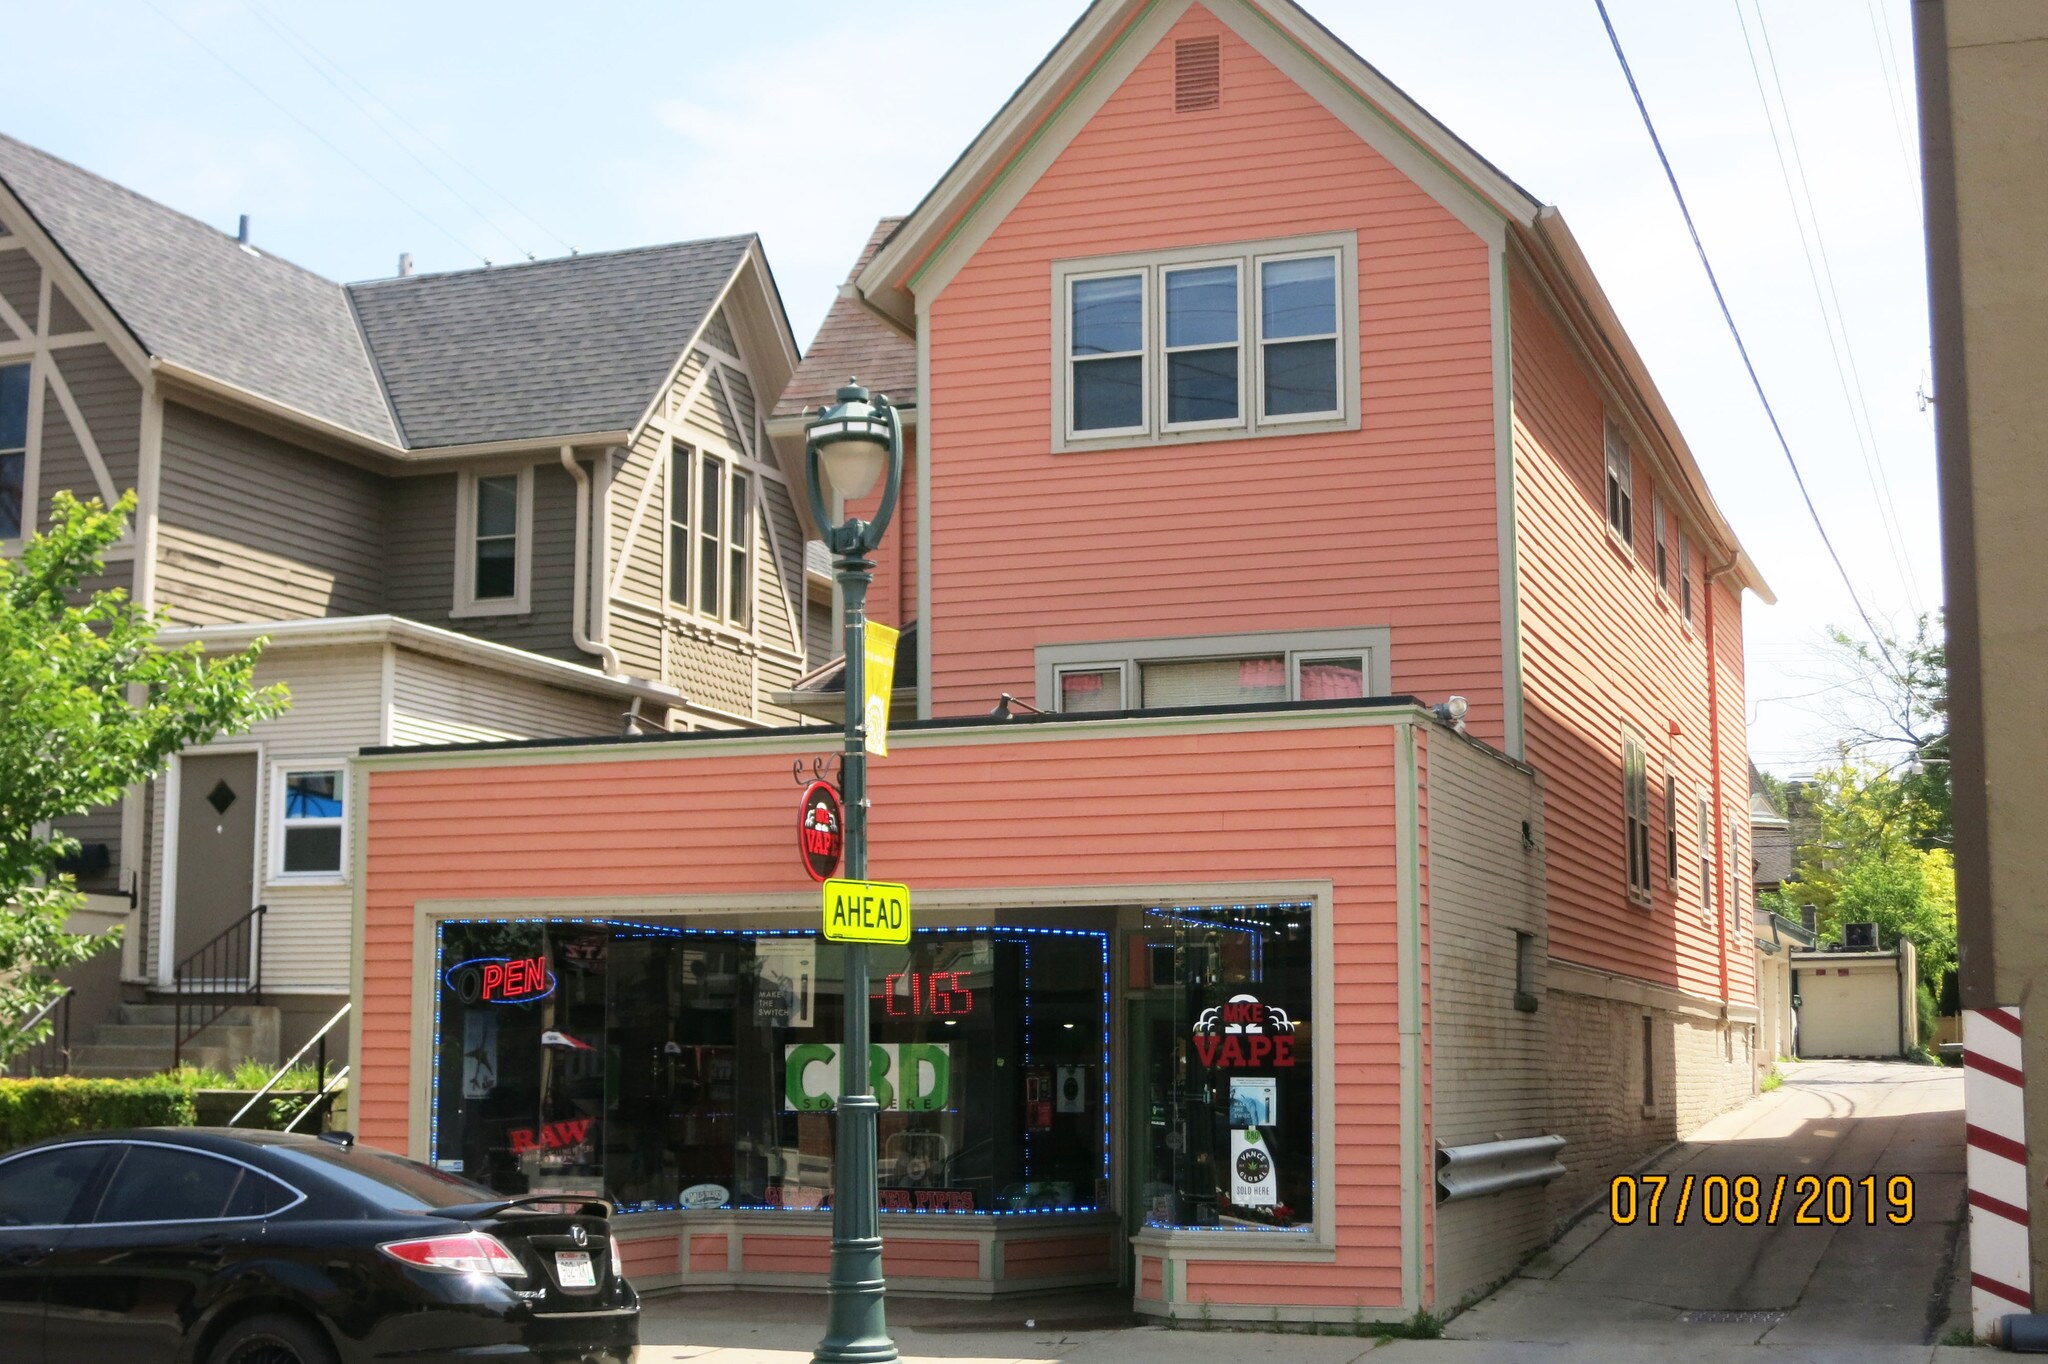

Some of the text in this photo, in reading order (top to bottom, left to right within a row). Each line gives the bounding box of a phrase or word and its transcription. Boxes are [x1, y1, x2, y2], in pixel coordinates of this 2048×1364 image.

[805, 829, 838, 857] VAPE
[833, 895, 903, 930] AHEAD
[458, 956, 546, 1004] OPEN
[758, 1008, 789, 1016] SWITCH
[1222, 1003, 1264, 1022] MKE
[1192, 1035, 1295, 1067] VAPE
[785, 1044, 949, 1111] CBD
[510, 1118, 590, 1154] RAW
[1246, 1131, 1259, 1140] CBD
[1240, 1151, 1266, 1162] VANCE
[1240, 1171, 1267, 1182] GLOBAL
[915, 1190, 974, 1210] PIPES
[1237, 1186, 1269, 1196] SOLD HERE
